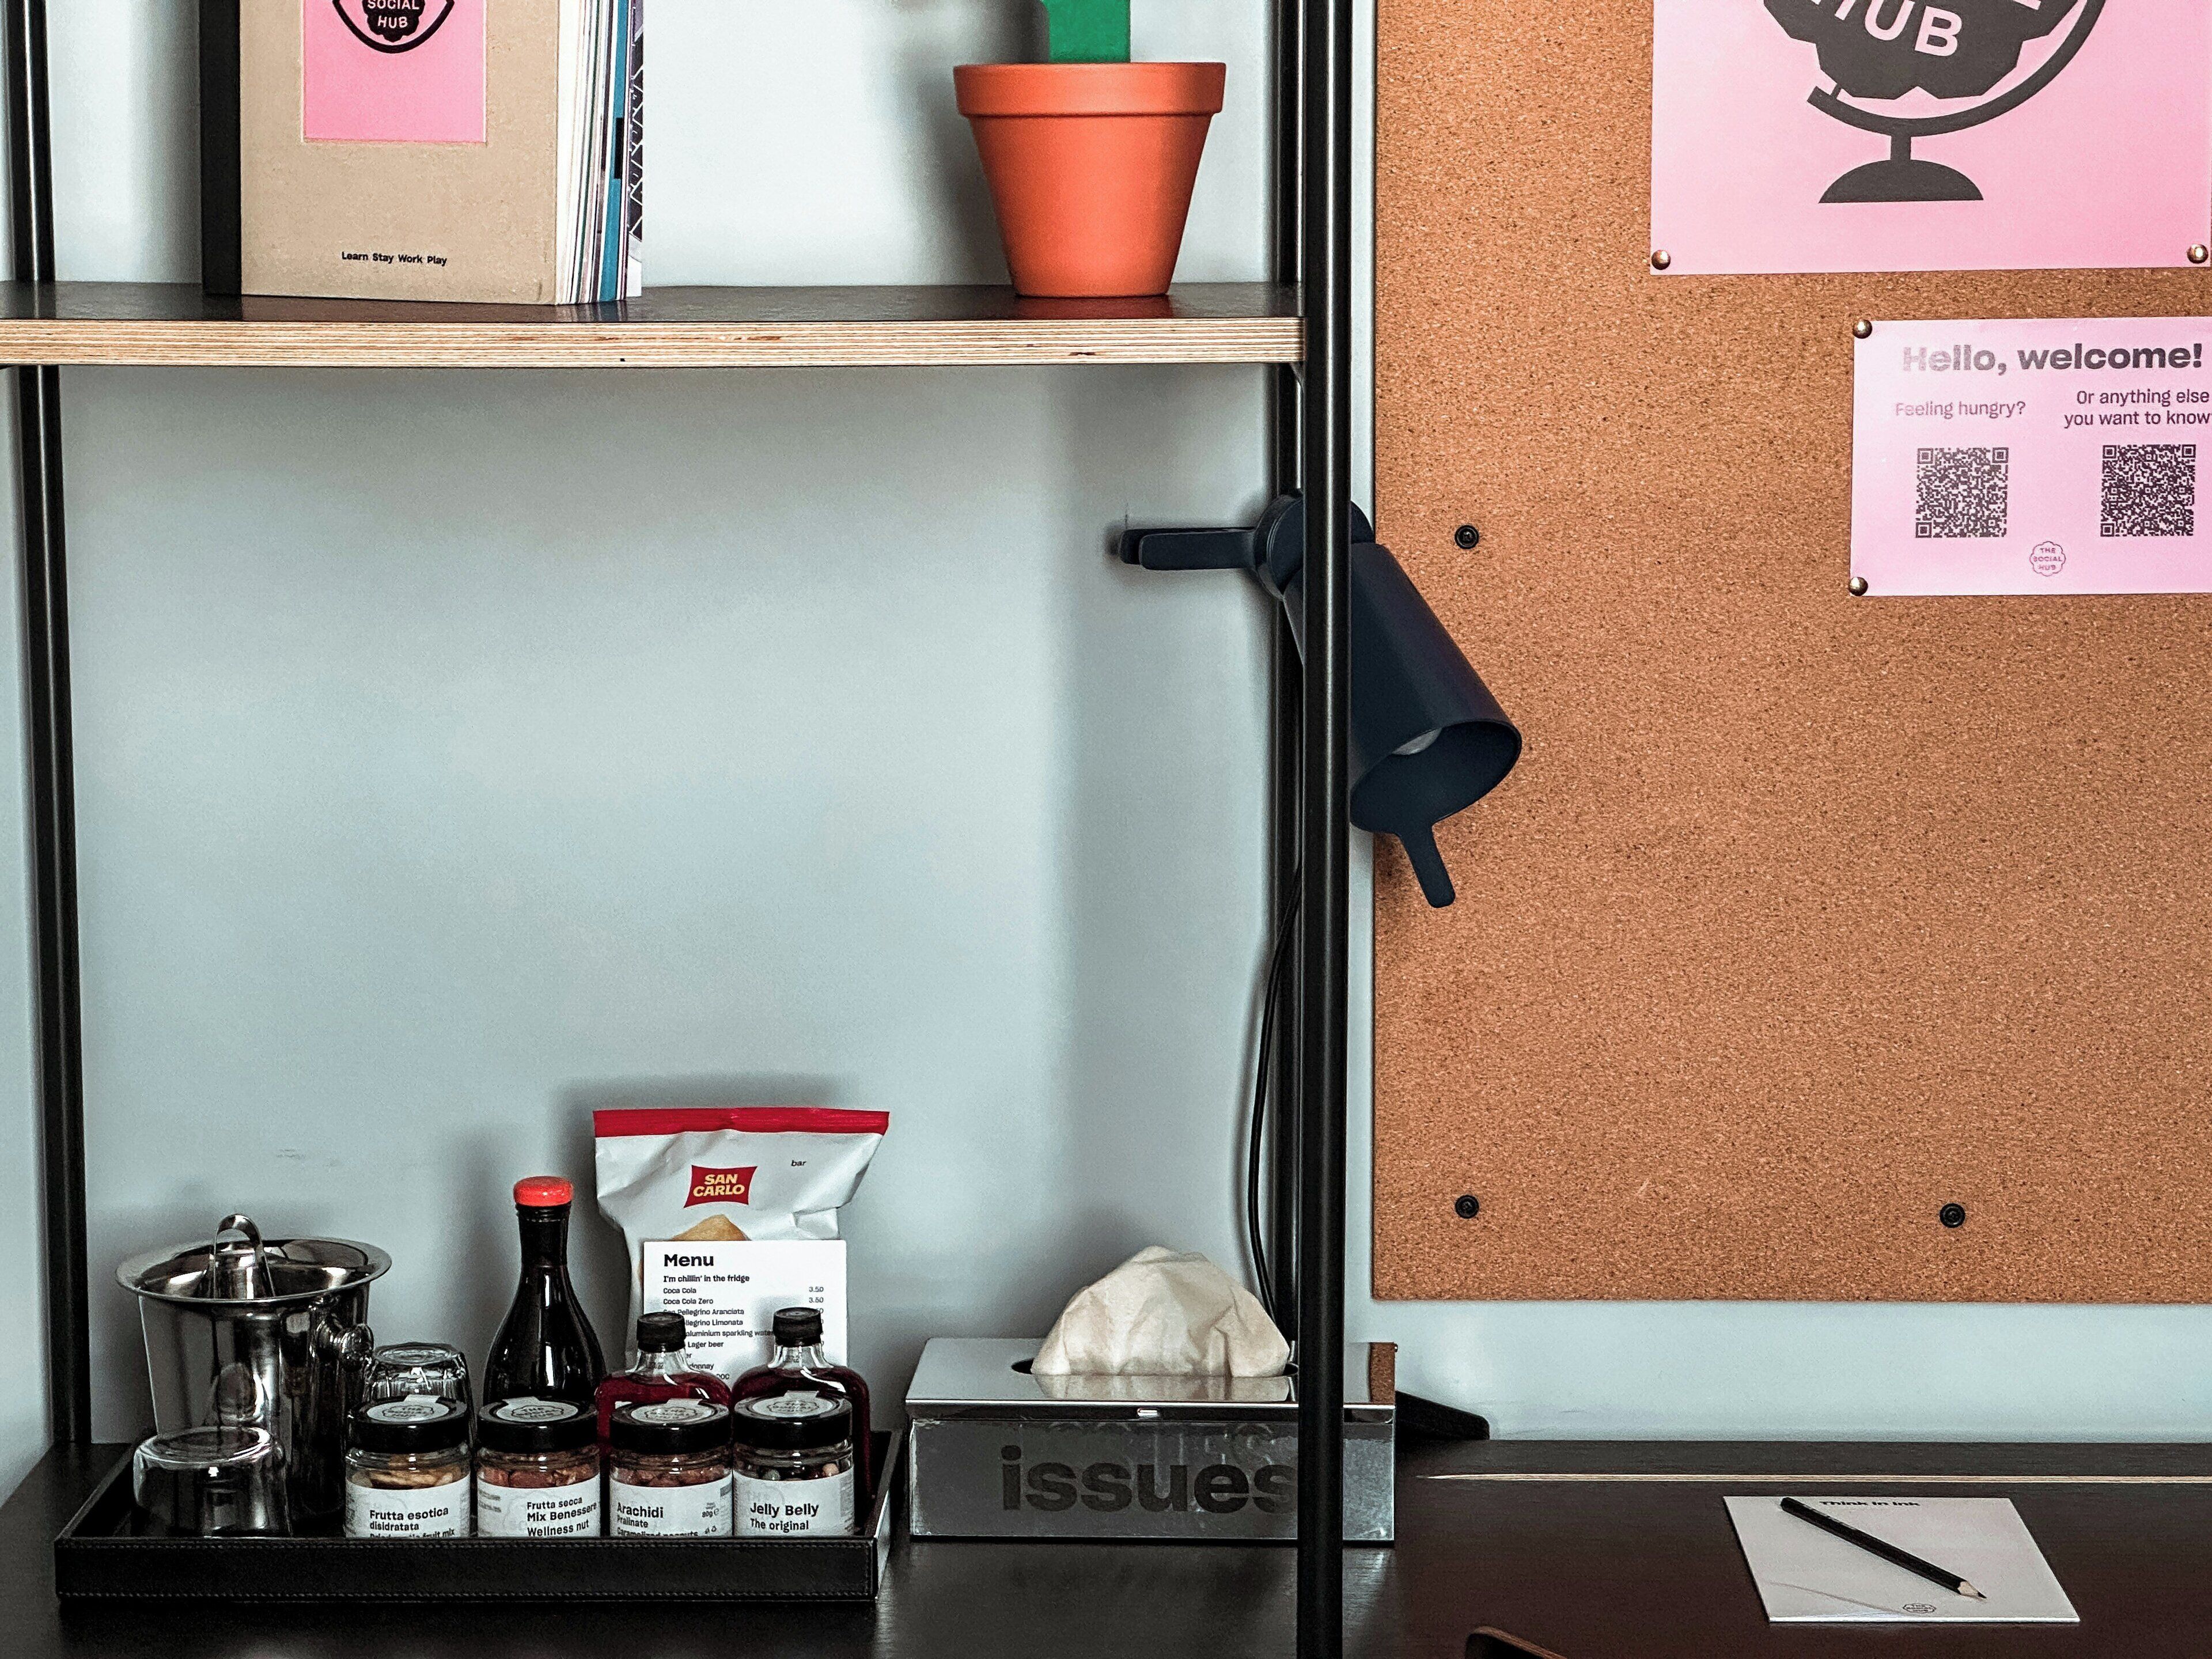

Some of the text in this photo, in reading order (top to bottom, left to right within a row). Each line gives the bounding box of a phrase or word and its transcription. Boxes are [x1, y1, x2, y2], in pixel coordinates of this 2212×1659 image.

[368, 0, 420, 10] SOCIAL
[377, 15, 408, 28] HUB
[342, 251, 448, 267] Learn Stay Work Play
[1903, 343, 2202, 376] Hello, welcome!
[2077, 388, 2210, 407] Or anything else
[1895, 401, 2027, 419] Feeling hungry?
[2064, 410, 2212, 429] you want to know
[704, 1174, 738, 1185] SAN
[693, 1184, 745, 1196] CARLO
[664, 1254, 714, 1267] Menu
[728, 1275, 749, 1283] fridge
[685, 1320, 710, 1328] llegrino
[688, 1341, 706, 1349] Lager
[1001, 1445, 1298, 1514] issues
[527, 1501, 556, 1510] Frutta
[617, 1502, 664, 1518] Arachidi
[750, 1502, 819, 1518] Jelly Belly
[370, 1507, 449, 1521] Frutta esotica
[527, 1512, 546, 1522] Mix
[617, 1514, 649, 1528] Pralinate
[370, 1521, 419, 1531] disidratata
[527, 1519, 589, 1537] Wellness nut
[750, 1518, 809, 1533] The original
